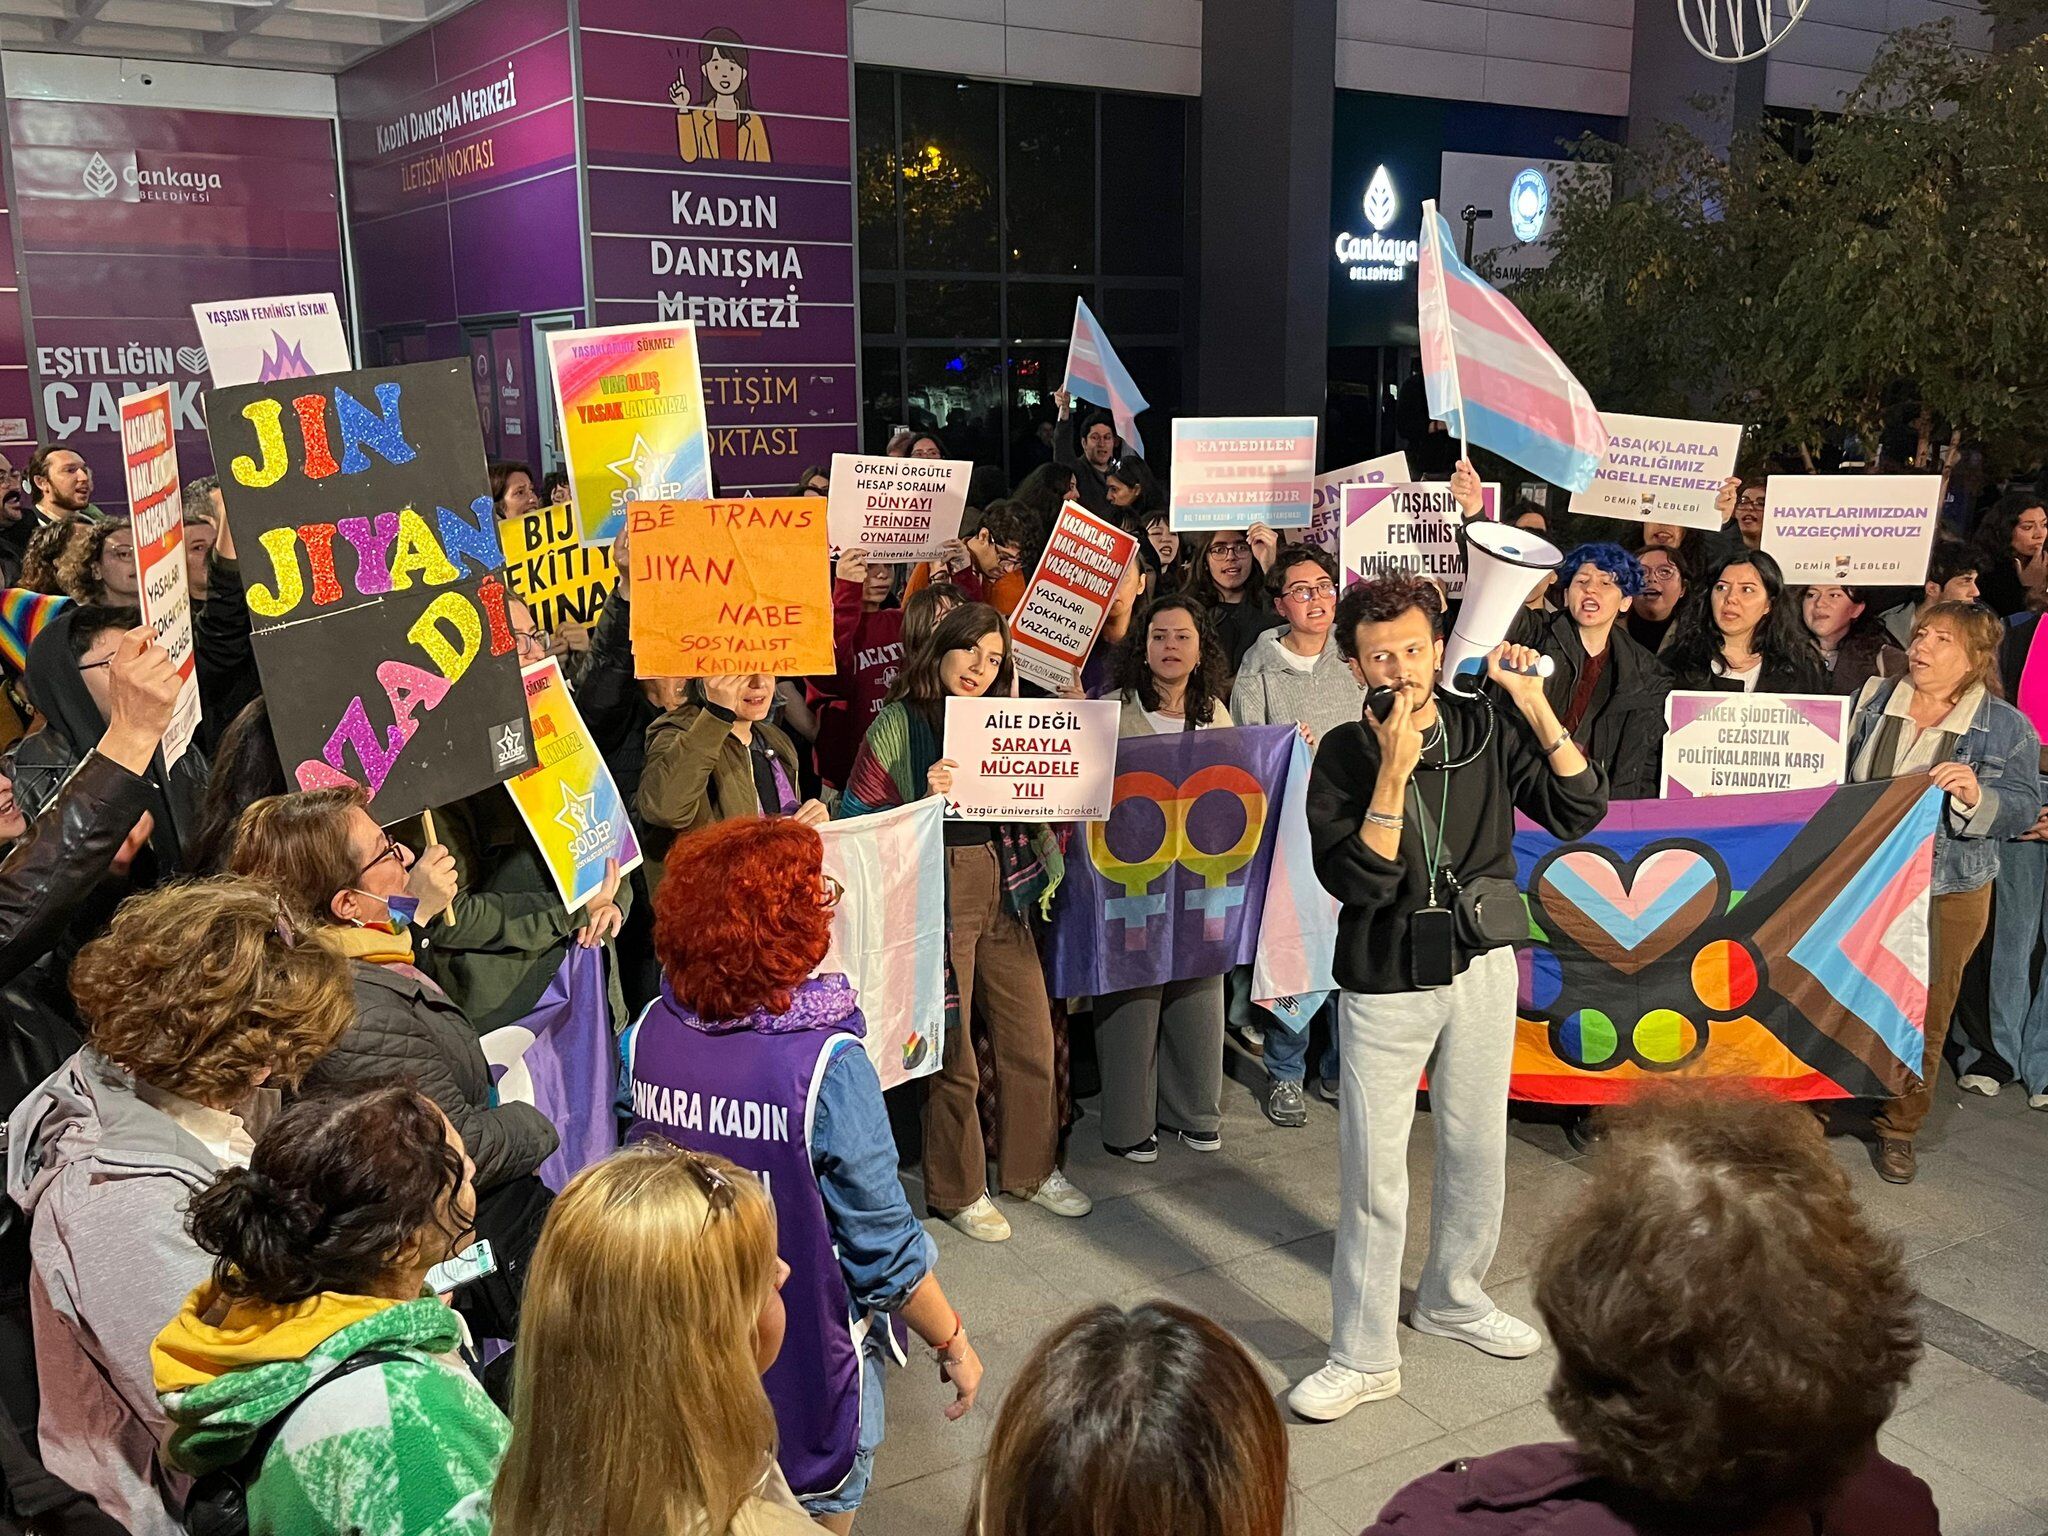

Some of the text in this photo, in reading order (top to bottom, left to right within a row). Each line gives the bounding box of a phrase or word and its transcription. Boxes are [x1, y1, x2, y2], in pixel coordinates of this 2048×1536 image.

[376, 61, 517, 154] KADIN DANIŞMA MERKEZİ
[446, 139, 495, 178] NOKTASI
[122, 166, 221, 192] Çankaya
[139, 190, 210, 203] BELEDİYESİ
[671, 190, 777, 229] KADIN
[1335, 231, 1418, 267] Çankaya
[651, 240, 803, 288] DANIŞMA
[206, 301, 330, 327] YAŞASIN FEMİNİST İSYAN!
[657, 284, 800, 328] MERKEZİ
[702, 368, 799, 414] ETİŞİM
[231, 382, 417, 488] JIN
[1608, 435, 1719, 457] ASA(K)LARLA
[854, 461, 952, 478] ÖFKENİ ÖRGÜTLE
[1609, 453, 1705, 473] VARLIĞIMIZ
[857, 480, 946, 493] HESAP SORALIM
[1594, 468, 1722, 492] NGELLENEMEZ!
[867, 492, 932, 510] DÜNYAYI
[1391, 492, 1457, 519] YAŞASIN
[1604, 494, 1700, 513] DEMİR LEBLEBİ
[1773, 507, 1928, 518] HAYATLARIMIZDAN
[631, 503, 812, 533] BÊ TRANS
[864, 512, 931, 528] YERİNDEN
[860, 532, 930, 543] OYNATALIM!
[1060, 513, 1116, 555] KAZANILMIŞ
[1388, 519, 1461, 544] FEMİNİST
[1776, 524, 1922, 540] VAZGEÇMİYORUZ!
[246, 495, 506, 617] JIYAN
[1052, 533, 1123, 579] HAKLARIMIZDAN
[1795, 560, 1900, 570] DEMİR LEBLEBİ
[637, 555, 735, 586] JIYAN
[1045, 554, 1113, 597] VAZGEÇMİYORUZ
[1036, 586, 1085, 614] YASALARI
[717, 602, 802, 627] NABE
[1026, 602, 1094, 637] SOKAKTA BİZ
[680, 635, 792, 652] SOSYALIST
[1019, 618, 1080, 650] YAZACAĞIZ!
[696, 655, 799, 673] KADINLAR
[985, 710, 1081, 730] AİLE DEĞİL
[992, 737, 1072, 753] SARAYLA
[1718, 728, 1790, 746] CEZASIZLIK
[981, 756, 1080, 775] MÜCADELE
[1678, 746, 1825, 773] POLİTİKALARINA KARŞI
[1012, 783, 1044, 797] YILI
[1711, 767, 1791, 789] İSYANDAYIZ!
[966, 806, 998, 818] özgür
[1001, 806, 1054, 816] üniversite
[567, 820, 611, 861] SOLDEP
[709, 1095, 789, 1142] KADIN
